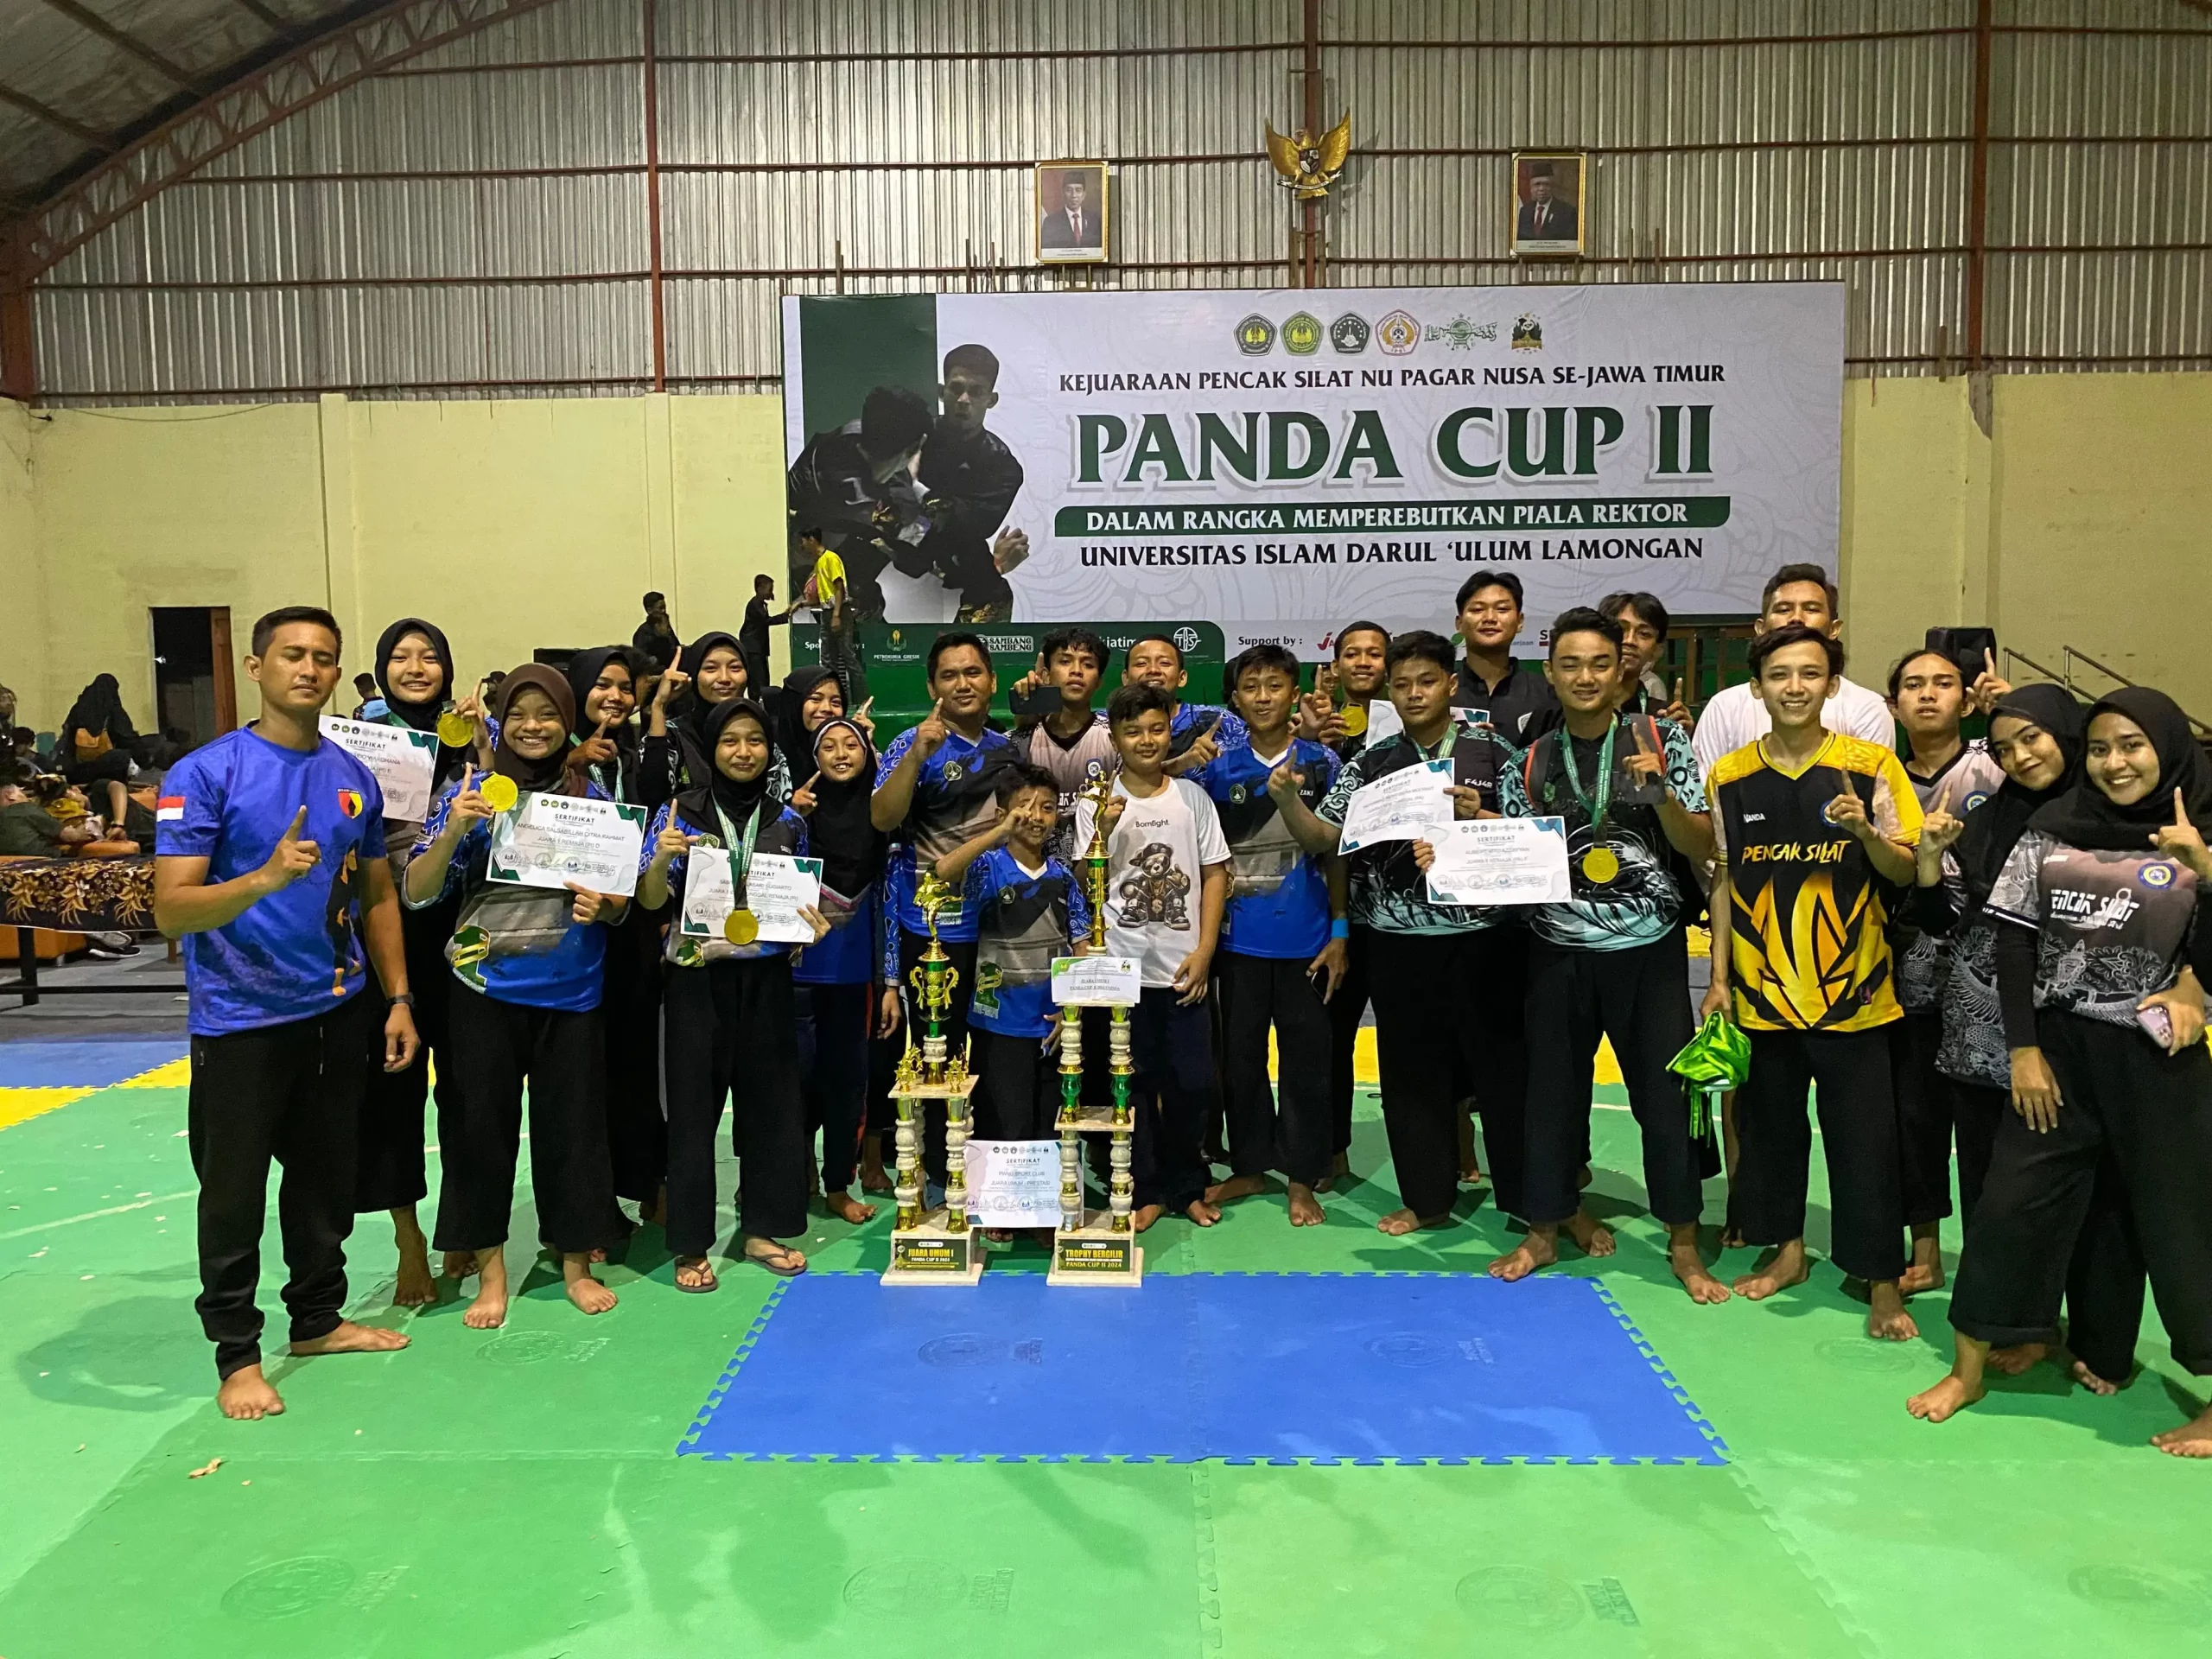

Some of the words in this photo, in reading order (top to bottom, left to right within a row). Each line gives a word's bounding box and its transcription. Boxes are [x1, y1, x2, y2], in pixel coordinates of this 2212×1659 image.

[1059, 372, 1191, 396] KEJUARAAN
[1199, 371, 1287, 390] PENCAK
[1294, 370, 1354, 388] SILAT
[1361, 369, 1393, 387] NU
[1401, 368, 1476, 386] PAGAR
[1484, 367, 1546, 385] NUSA
[1553, 365, 1646, 388] SE-JAWA
[1654, 365, 1726, 383] TIMUR
[1074, 410, 1404, 484] PANDA
[1434, 407, 1624, 480] CUP
[1655, 405, 1713, 474] II
[1086, 511, 1175, 531] DALAM
[1182, 510, 1284, 530] RANGKA
[1292, 506, 1507, 529] MEMPEREBUTKAN
[1512, 505, 1586, 524] PIALA
[1592, 504, 1688, 524] REKTOR
[1080, 546, 1247, 567] UNIVERSITAS
[1255, 543, 1337, 564] ISLAM
[1346, 542, 1437, 563] DARUL
[1541, 537, 1704, 560] LAMONGAN
[1238, 636, 1280, 646] Support
[1283, 636, 1296, 646] by
[346, 739, 386, 749] SERTIFIKAT
[555, 813, 595, 823] SERTIFIKAT
[1741, 841, 1800, 864] PENCAK
[908, 1249, 928, 1257] JUARA
[929, 1249, 950, 1257] UMUM
[1065, 1249, 1092, 1258] TROPHY
